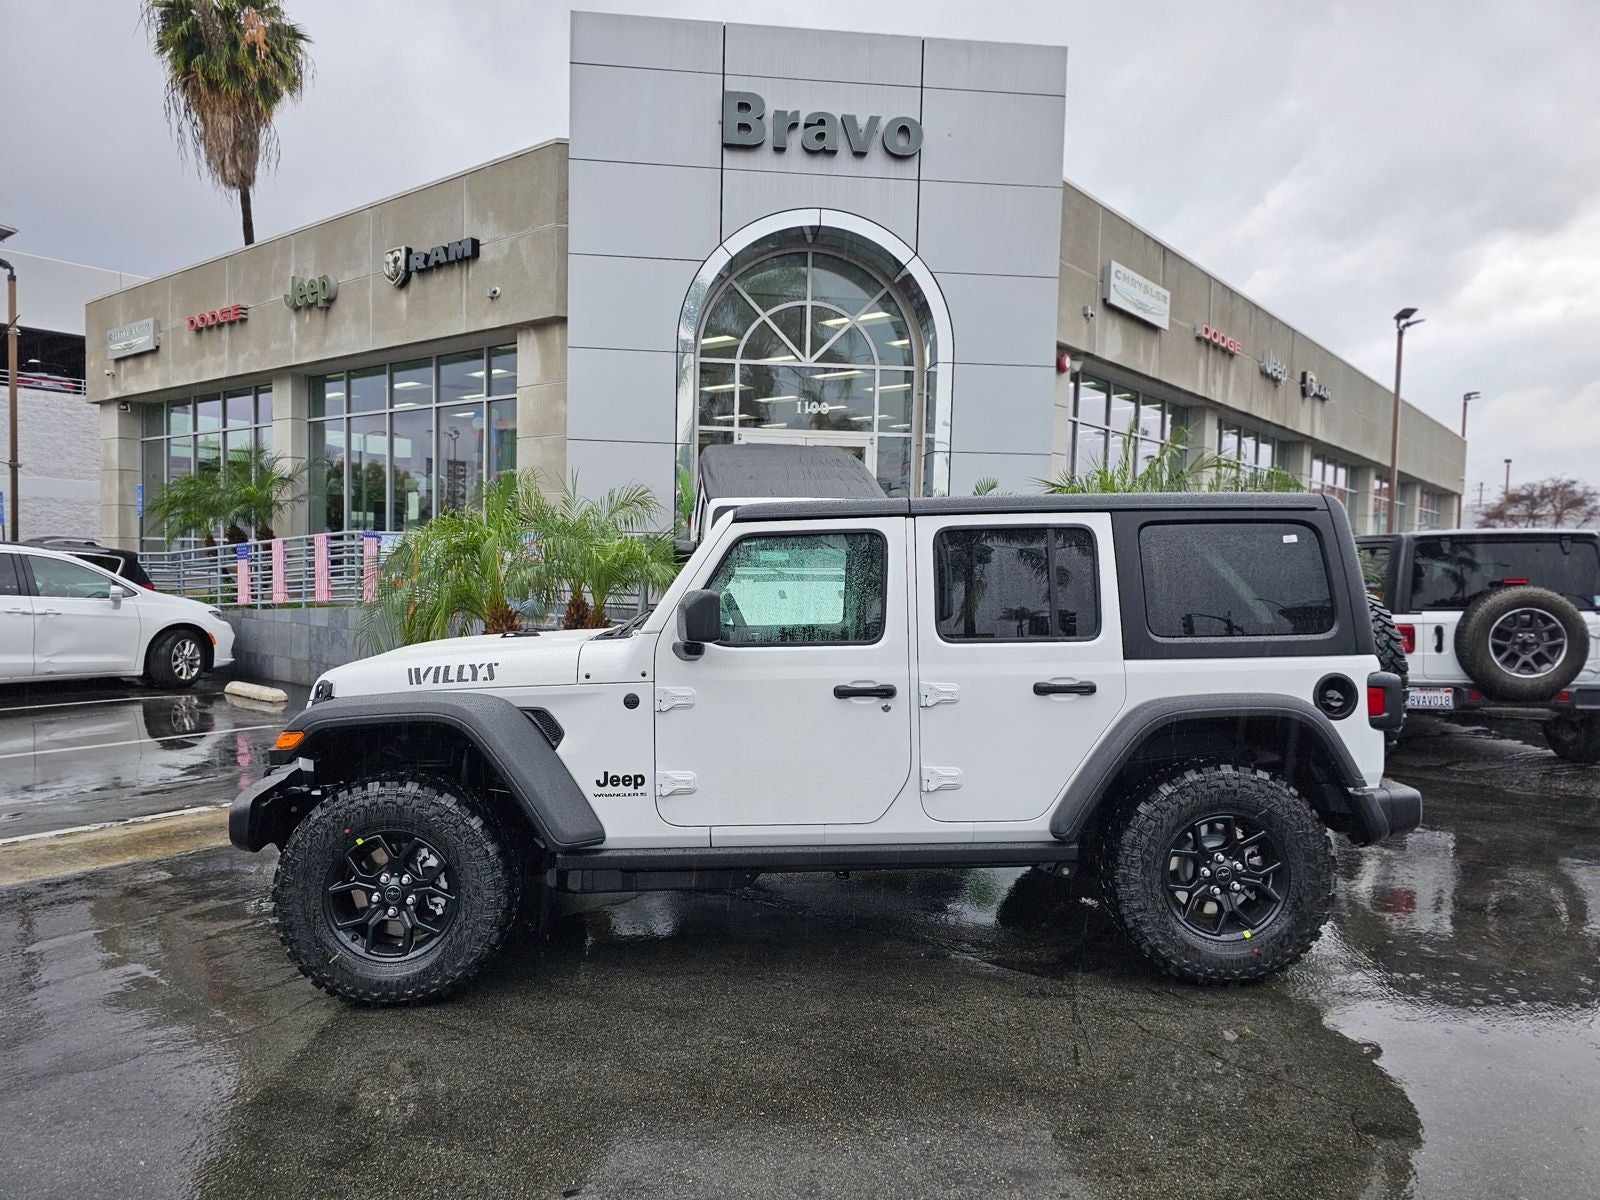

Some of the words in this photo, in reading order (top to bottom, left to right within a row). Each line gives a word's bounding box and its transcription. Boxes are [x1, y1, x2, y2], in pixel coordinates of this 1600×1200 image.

[723, 91, 924, 157] Bravo
[409, 238, 475, 272] RAM
[283, 274, 333, 310] Jeep
[1114, 269, 1169, 305] CHRYSLER
[187, 304, 243, 331] DODGE
[1202, 324, 1243, 355] DODGE
[1261, 348, 1288, 386] Jeep
[796, 401, 830, 415] 1100
[407, 662, 499, 686] WILLYS
[595, 771, 645, 790] Jeep
